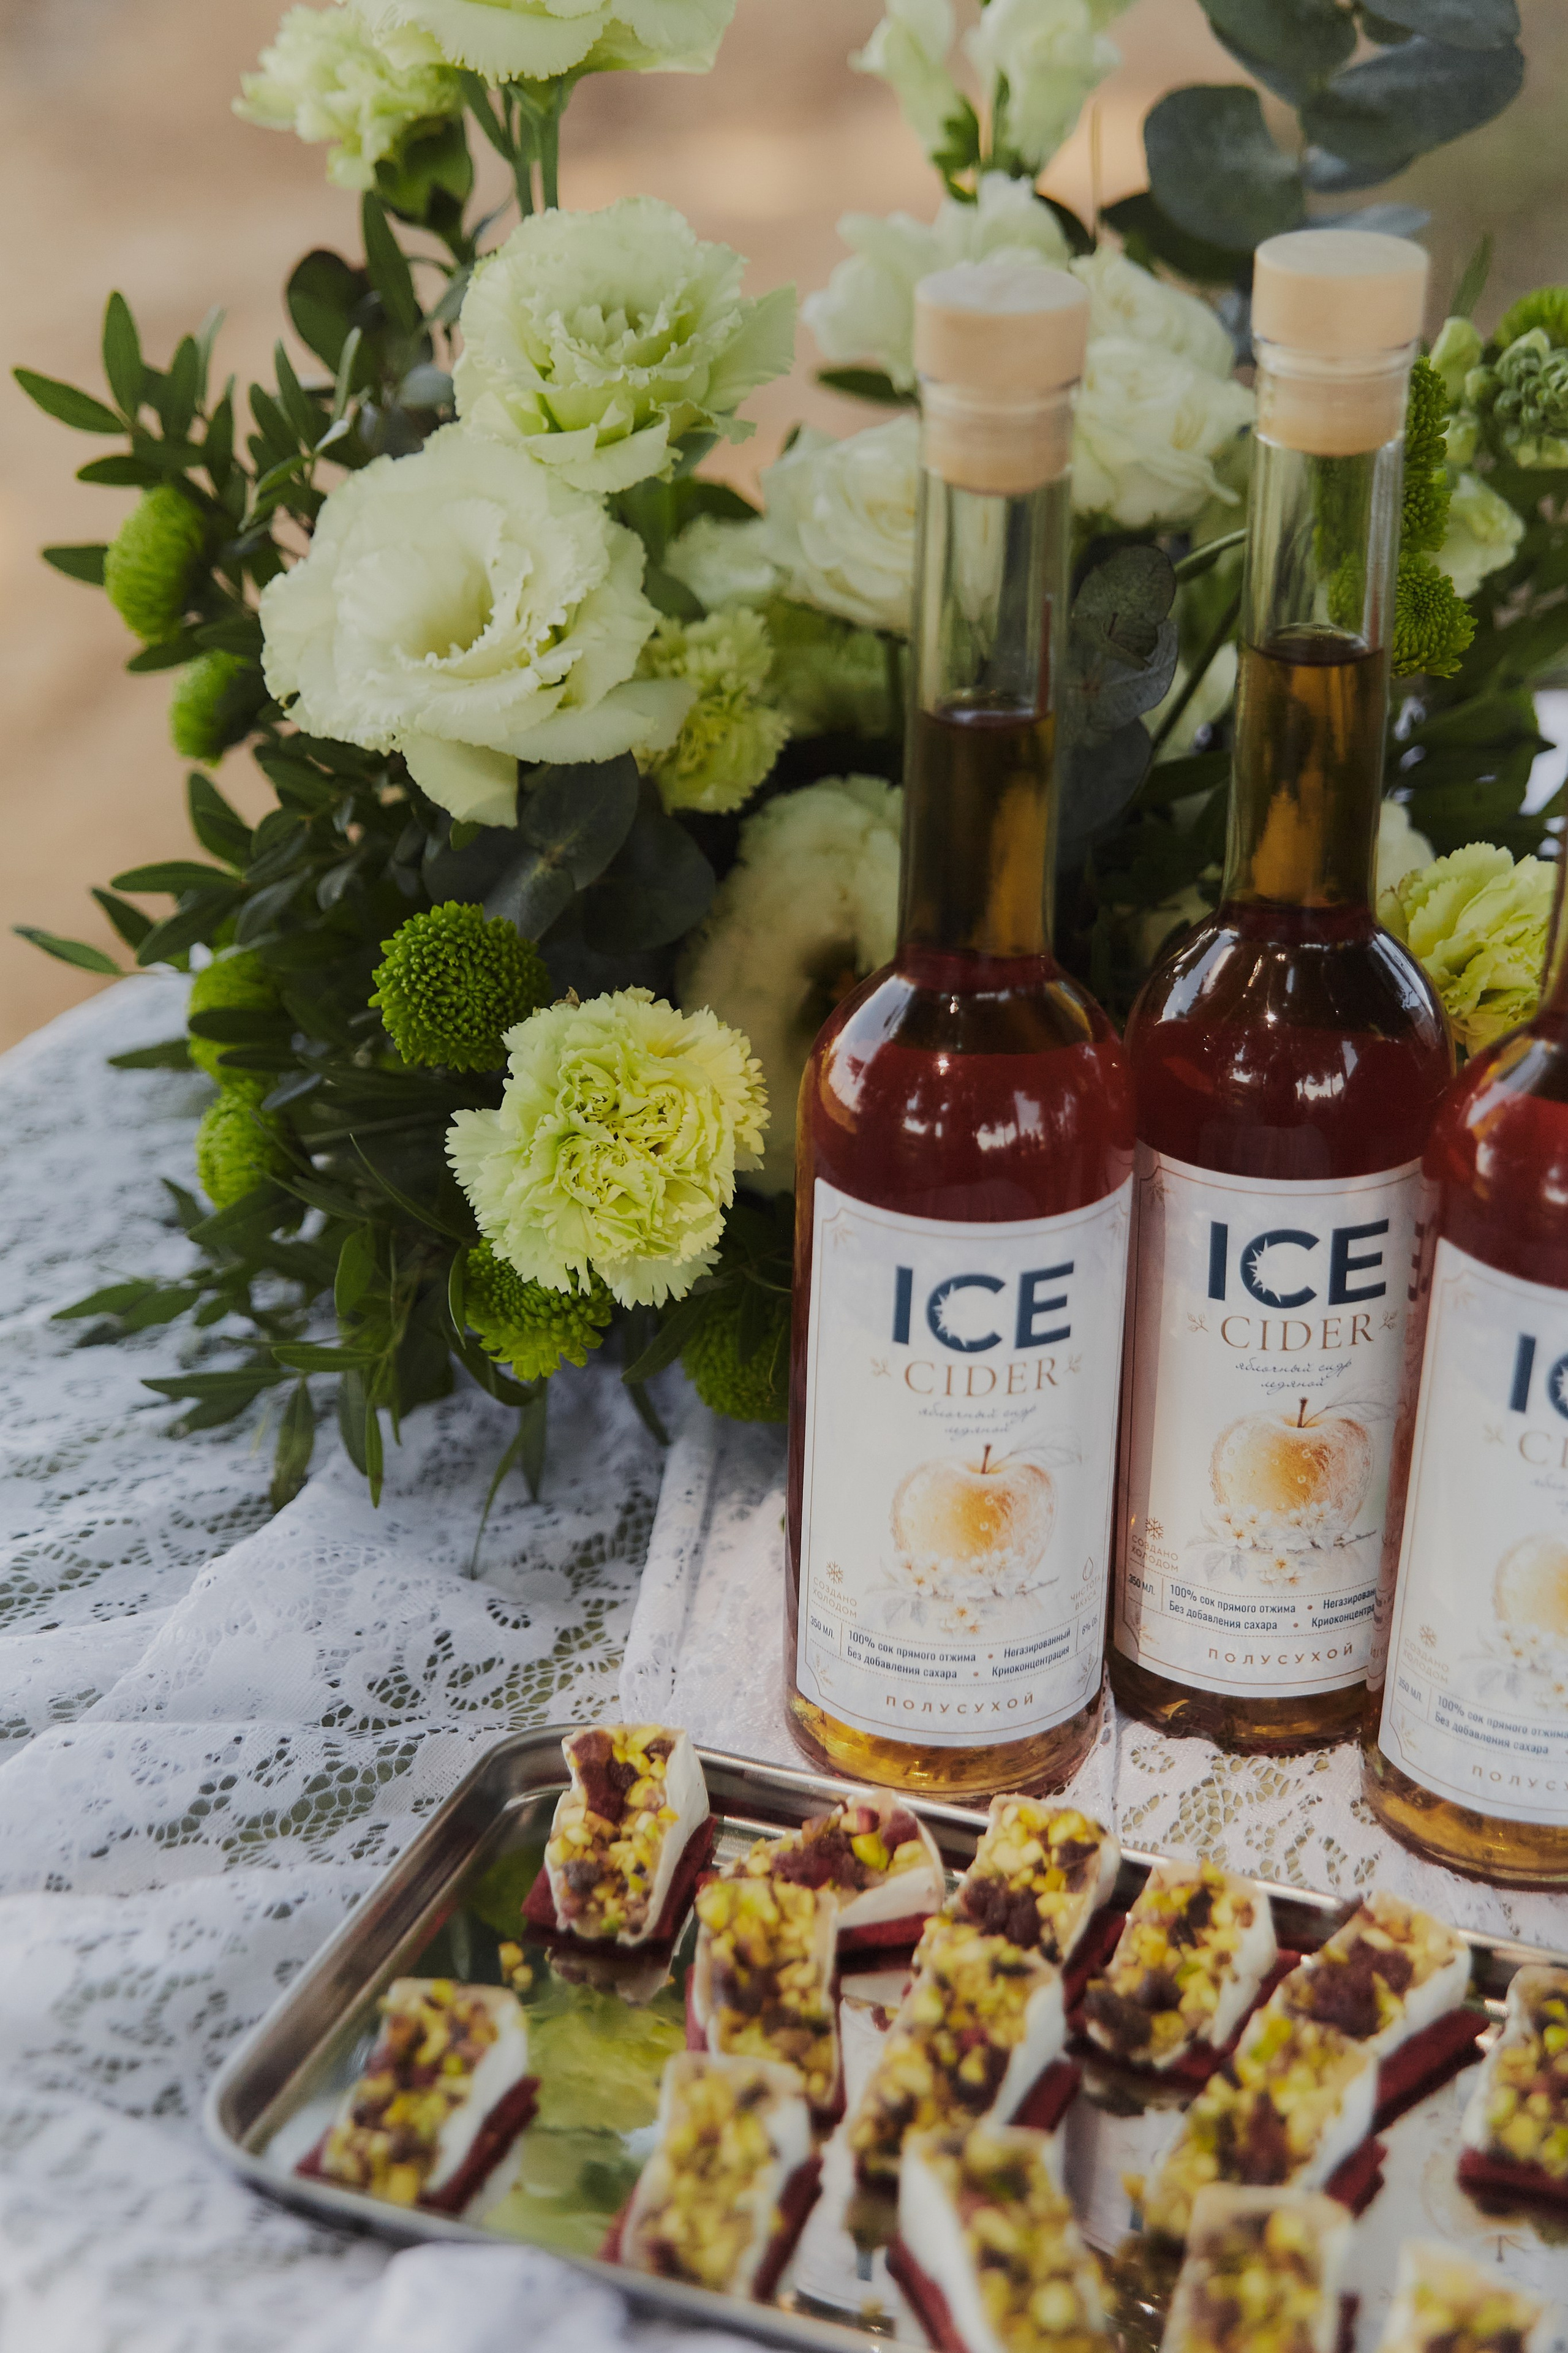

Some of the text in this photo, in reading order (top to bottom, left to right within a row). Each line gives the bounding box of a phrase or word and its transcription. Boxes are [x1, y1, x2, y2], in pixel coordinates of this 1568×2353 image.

[1208, 1218, 1389, 1309] ICE
[892, 1260, 1074, 1353] ICE
[1221, 1313, 1374, 1351] CIDER
[904, 1356, 1058, 1397] CIDER
[1131, 1546, 1178, 1572] ХОЛОДОМ
[1133, 1535, 1178, 1561] СОЗДАНО
[813, 1577, 857, 1607] СОЗДАНО
[813, 1587, 857, 1618] ХОЛОДОМ
[1170, 1584, 1197, 1602] 100%
[1200, 1595, 1215, 1607] сок
[1218, 1601, 1256, 1613] прямого
[810, 1615, 821, 1630] 350
[1169, 1600, 1184, 1614] Без
[1186, 1609, 1240, 1629] добавления
[1244, 1622, 1277, 1631] сахара
[848, 1627, 1071, 1662] 100% сок прямого отжима Негазированный
[1208, 1642, 1352, 1665] ПОЛУСУХОЙ
[848, 1645, 1070, 1680] Без добавления сахара Криоконцентрация
[886, 1691, 1033, 1714] ПОЛУСУХОЙ
[1438, 1696, 1464, 1717] 100%
[1468, 1710, 1483, 1724] сок
[1487, 1718, 1528, 1734] прямого
[1435, 1711, 1549, 1754] Без добавления сахара
